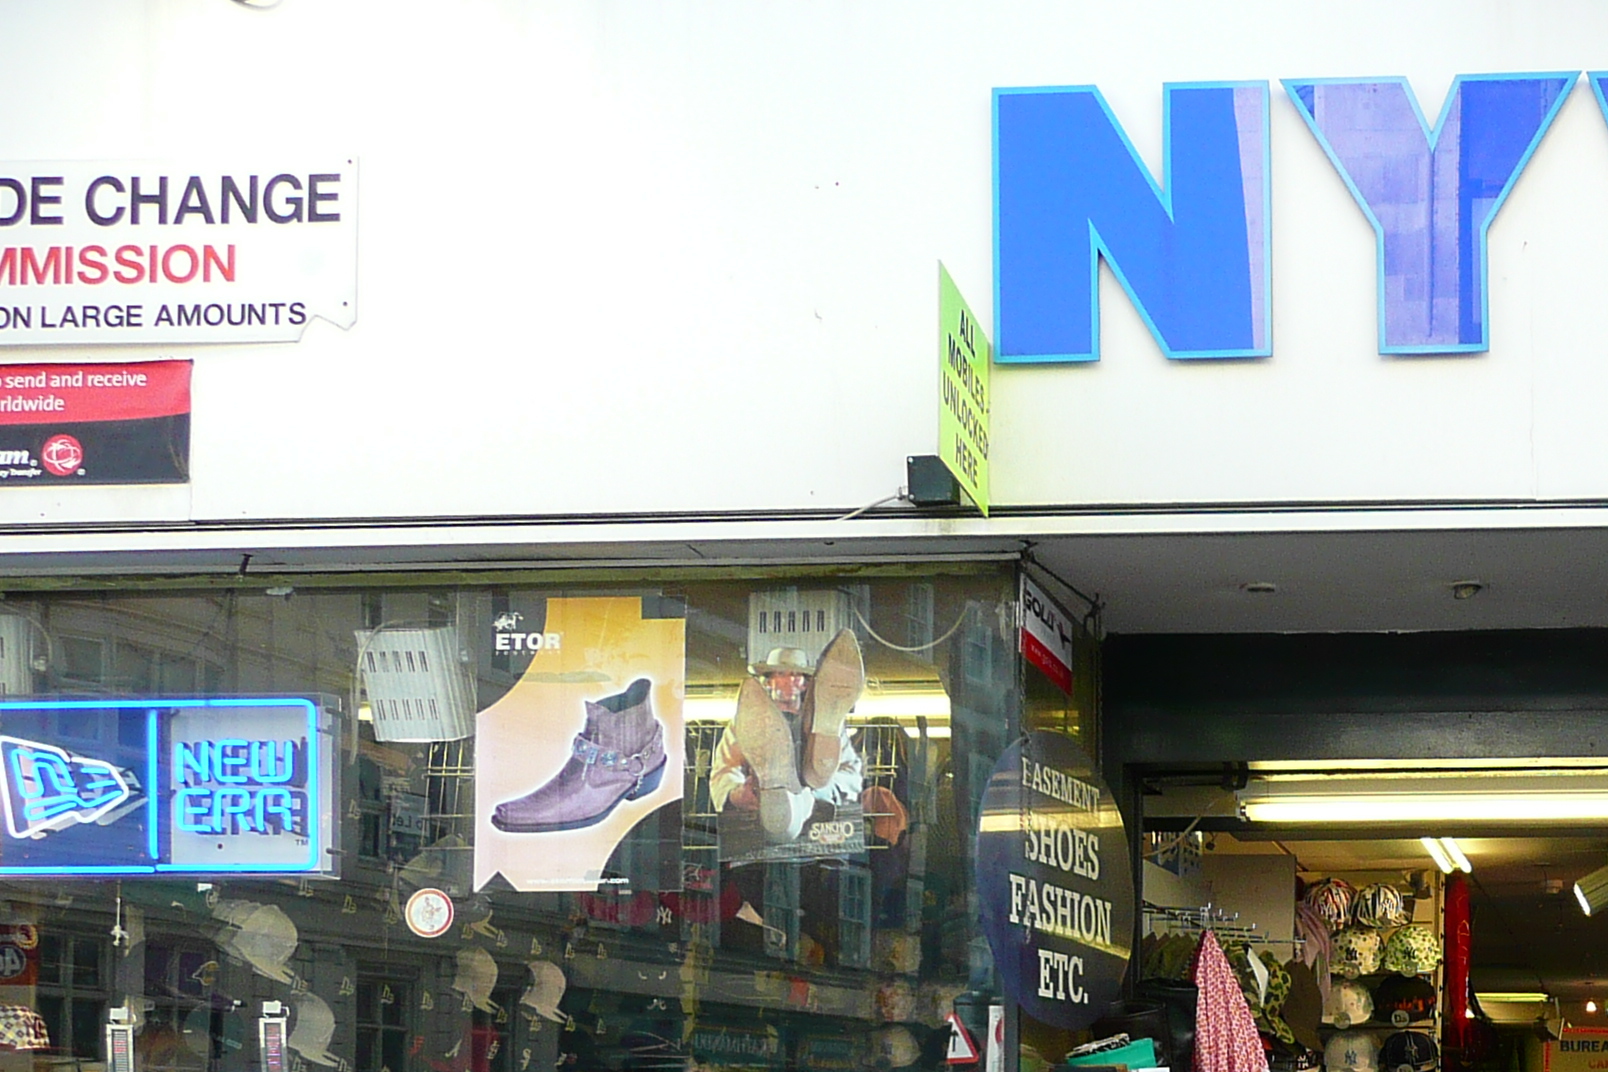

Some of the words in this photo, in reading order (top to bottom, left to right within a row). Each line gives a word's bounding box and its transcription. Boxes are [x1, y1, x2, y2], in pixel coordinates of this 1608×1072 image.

[85, 173, 341, 226] CHANGE
[40, 305, 143, 328] LARGE
[154, 302, 307, 328] AMOUNTS
[959, 309, 976, 358] ALL
[0, 395, 65, 412] rldwide
[5, 371, 46, 388] send
[50, 371, 83, 388] and
[87, 371, 147, 387] receive
[942, 370, 988, 461] UNLOCKED
[955, 432, 978, 489] HERE
[495, 633, 561, 651] ETOR
[175, 739, 296, 785] NEW
[175, 787, 293, 834] ERA
[809, 821, 854, 838] SANCHO
[1024, 811, 1100, 881] SHOES
[1008, 872, 1111, 946] FASHION
[1037, 949, 1089, 1005] ETC.
